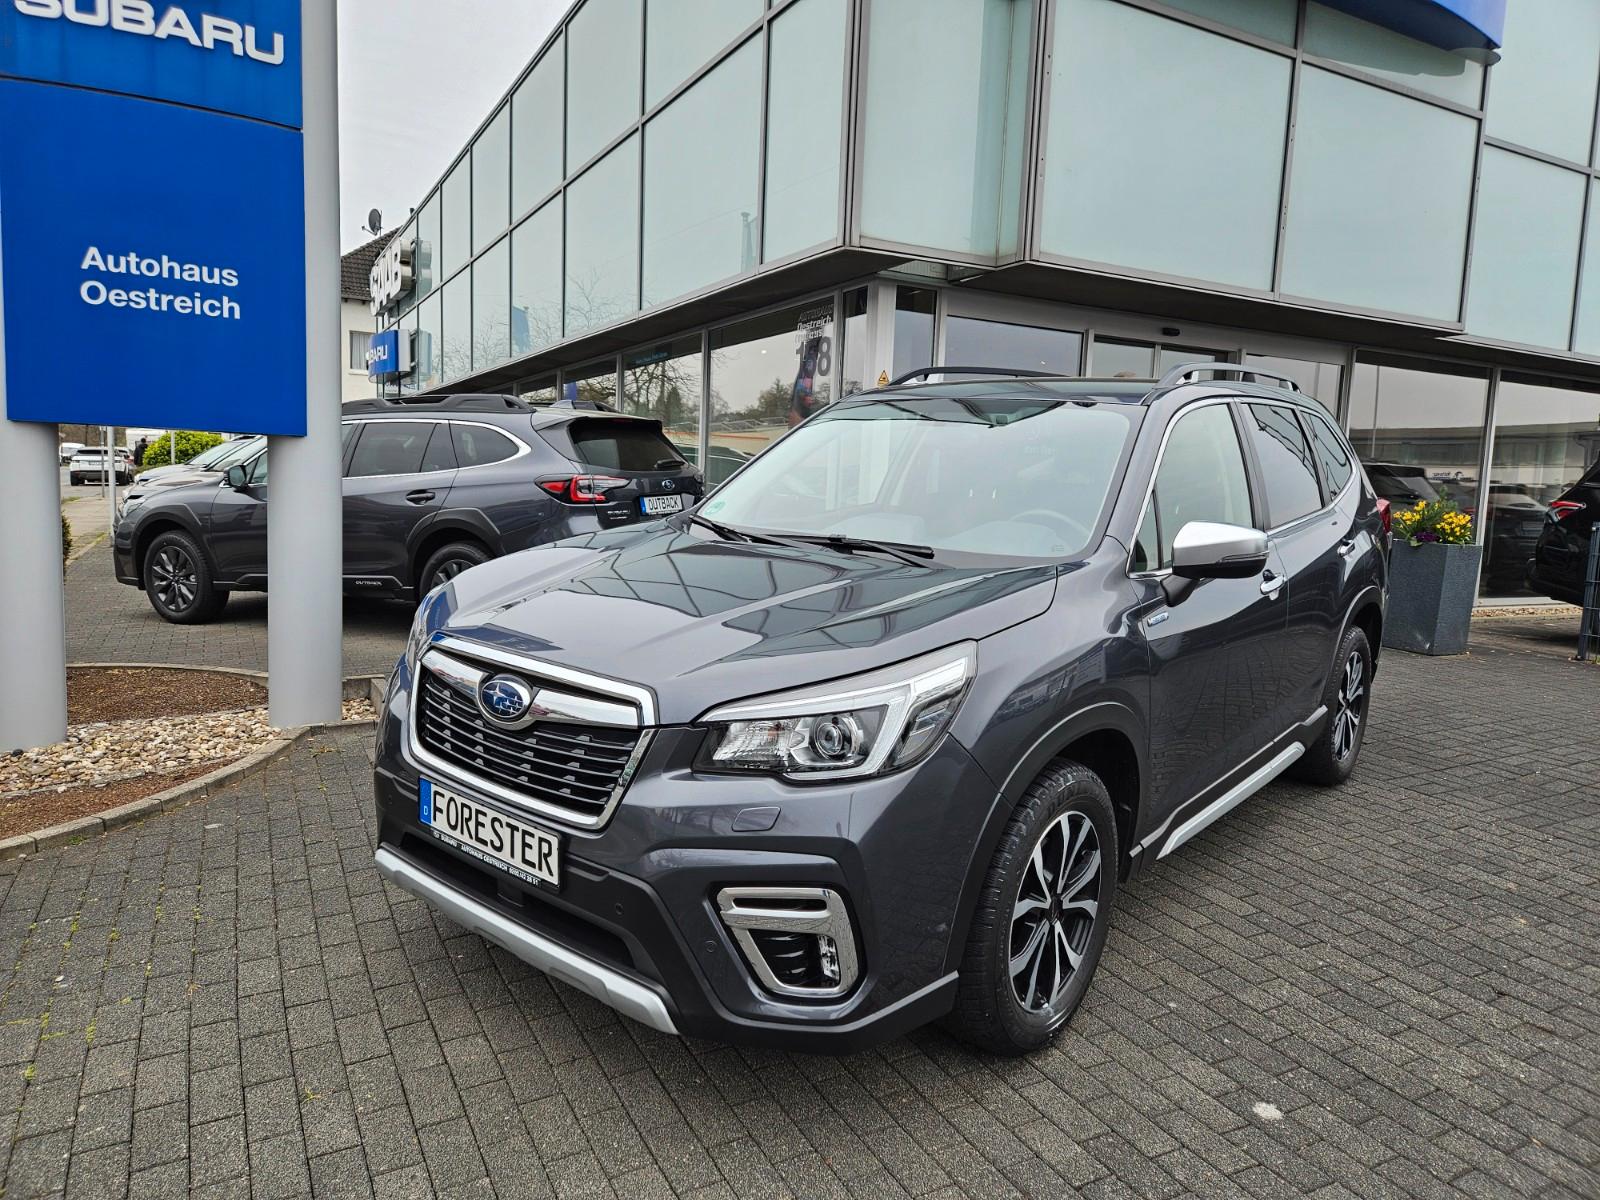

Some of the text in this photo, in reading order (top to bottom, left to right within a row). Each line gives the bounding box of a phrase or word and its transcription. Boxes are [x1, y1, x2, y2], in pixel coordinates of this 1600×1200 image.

[81, 246, 239, 287] Autohaus
[80, 280, 241, 320] Oestreich
[648, 496, 680, 511] OUTBACK
[423, 805, 429, 816] D
[432, 790, 554, 877] FORESTER
